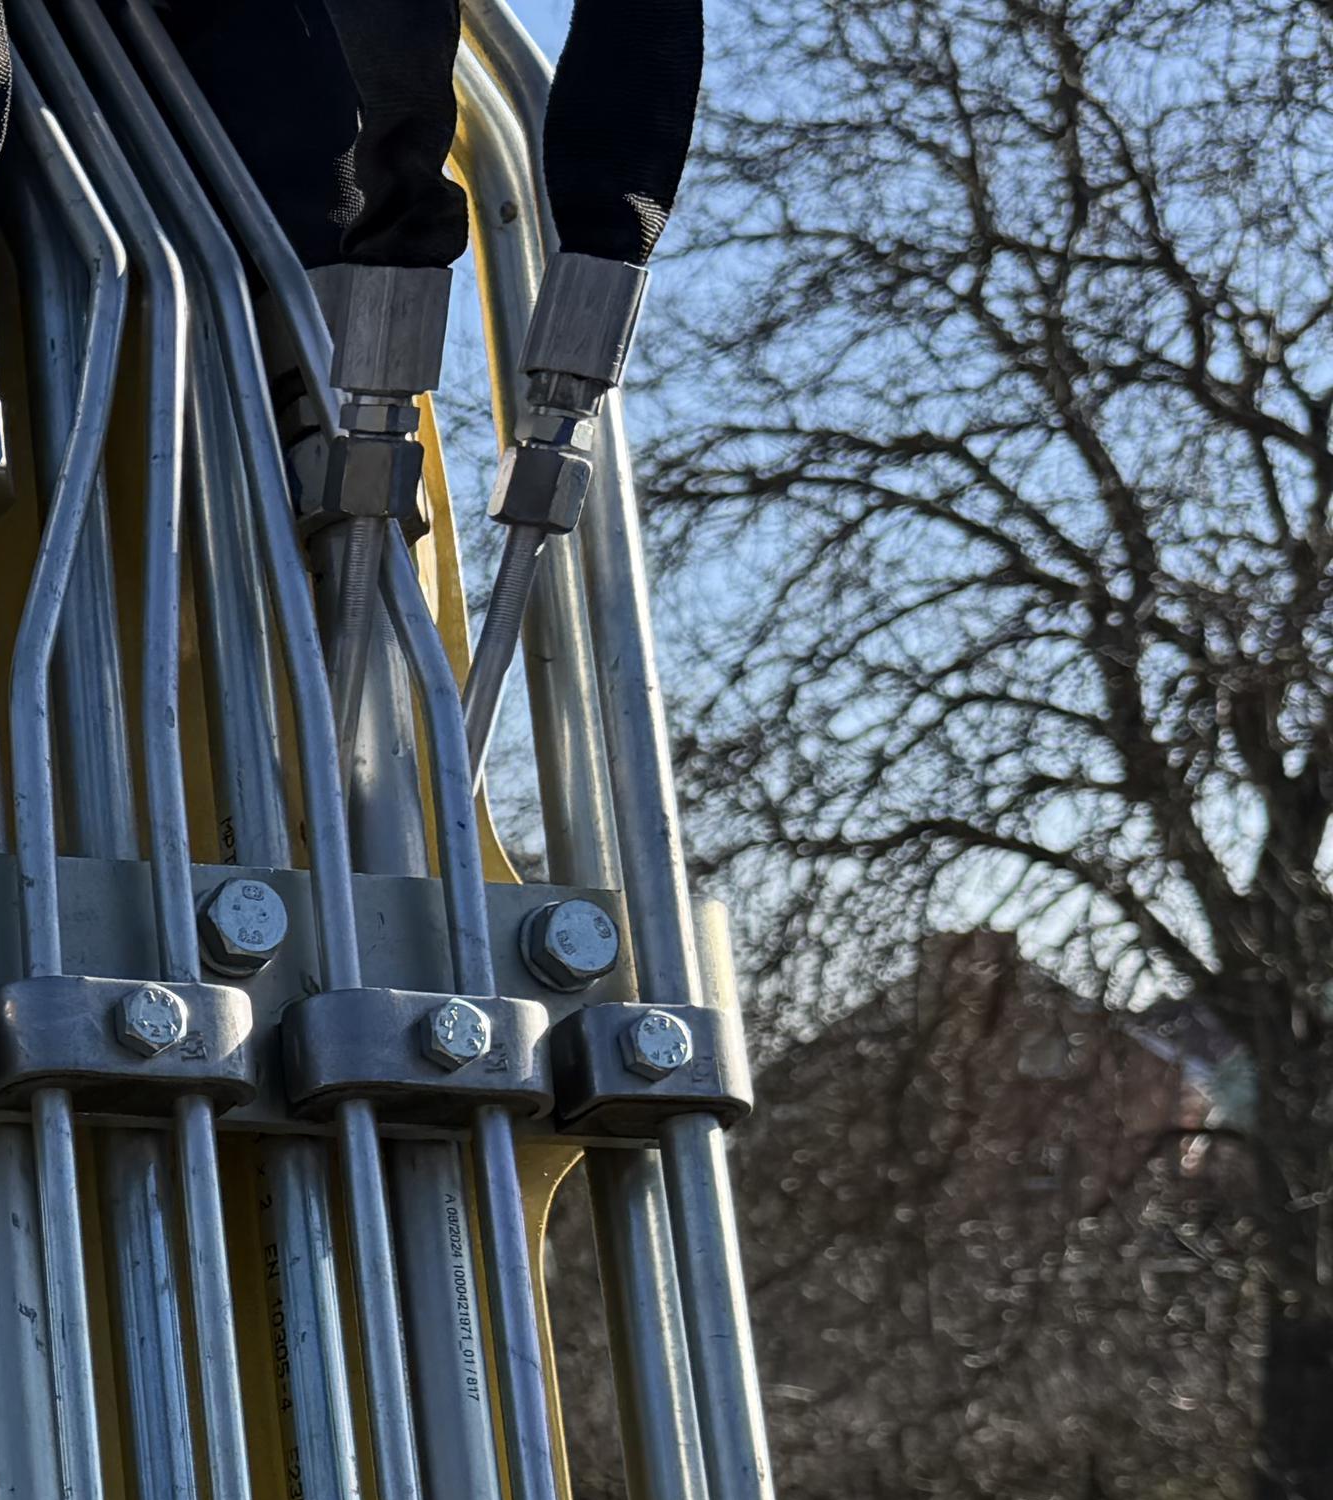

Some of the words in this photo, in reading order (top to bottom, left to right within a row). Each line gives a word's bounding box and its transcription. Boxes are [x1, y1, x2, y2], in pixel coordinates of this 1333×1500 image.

[263, 1243, 281, 1281] EN
[443, 1192, 456, 1205] A
[465, 1374, 481, 1403] 817
[270, 1294, 293, 1413] 10305-4
